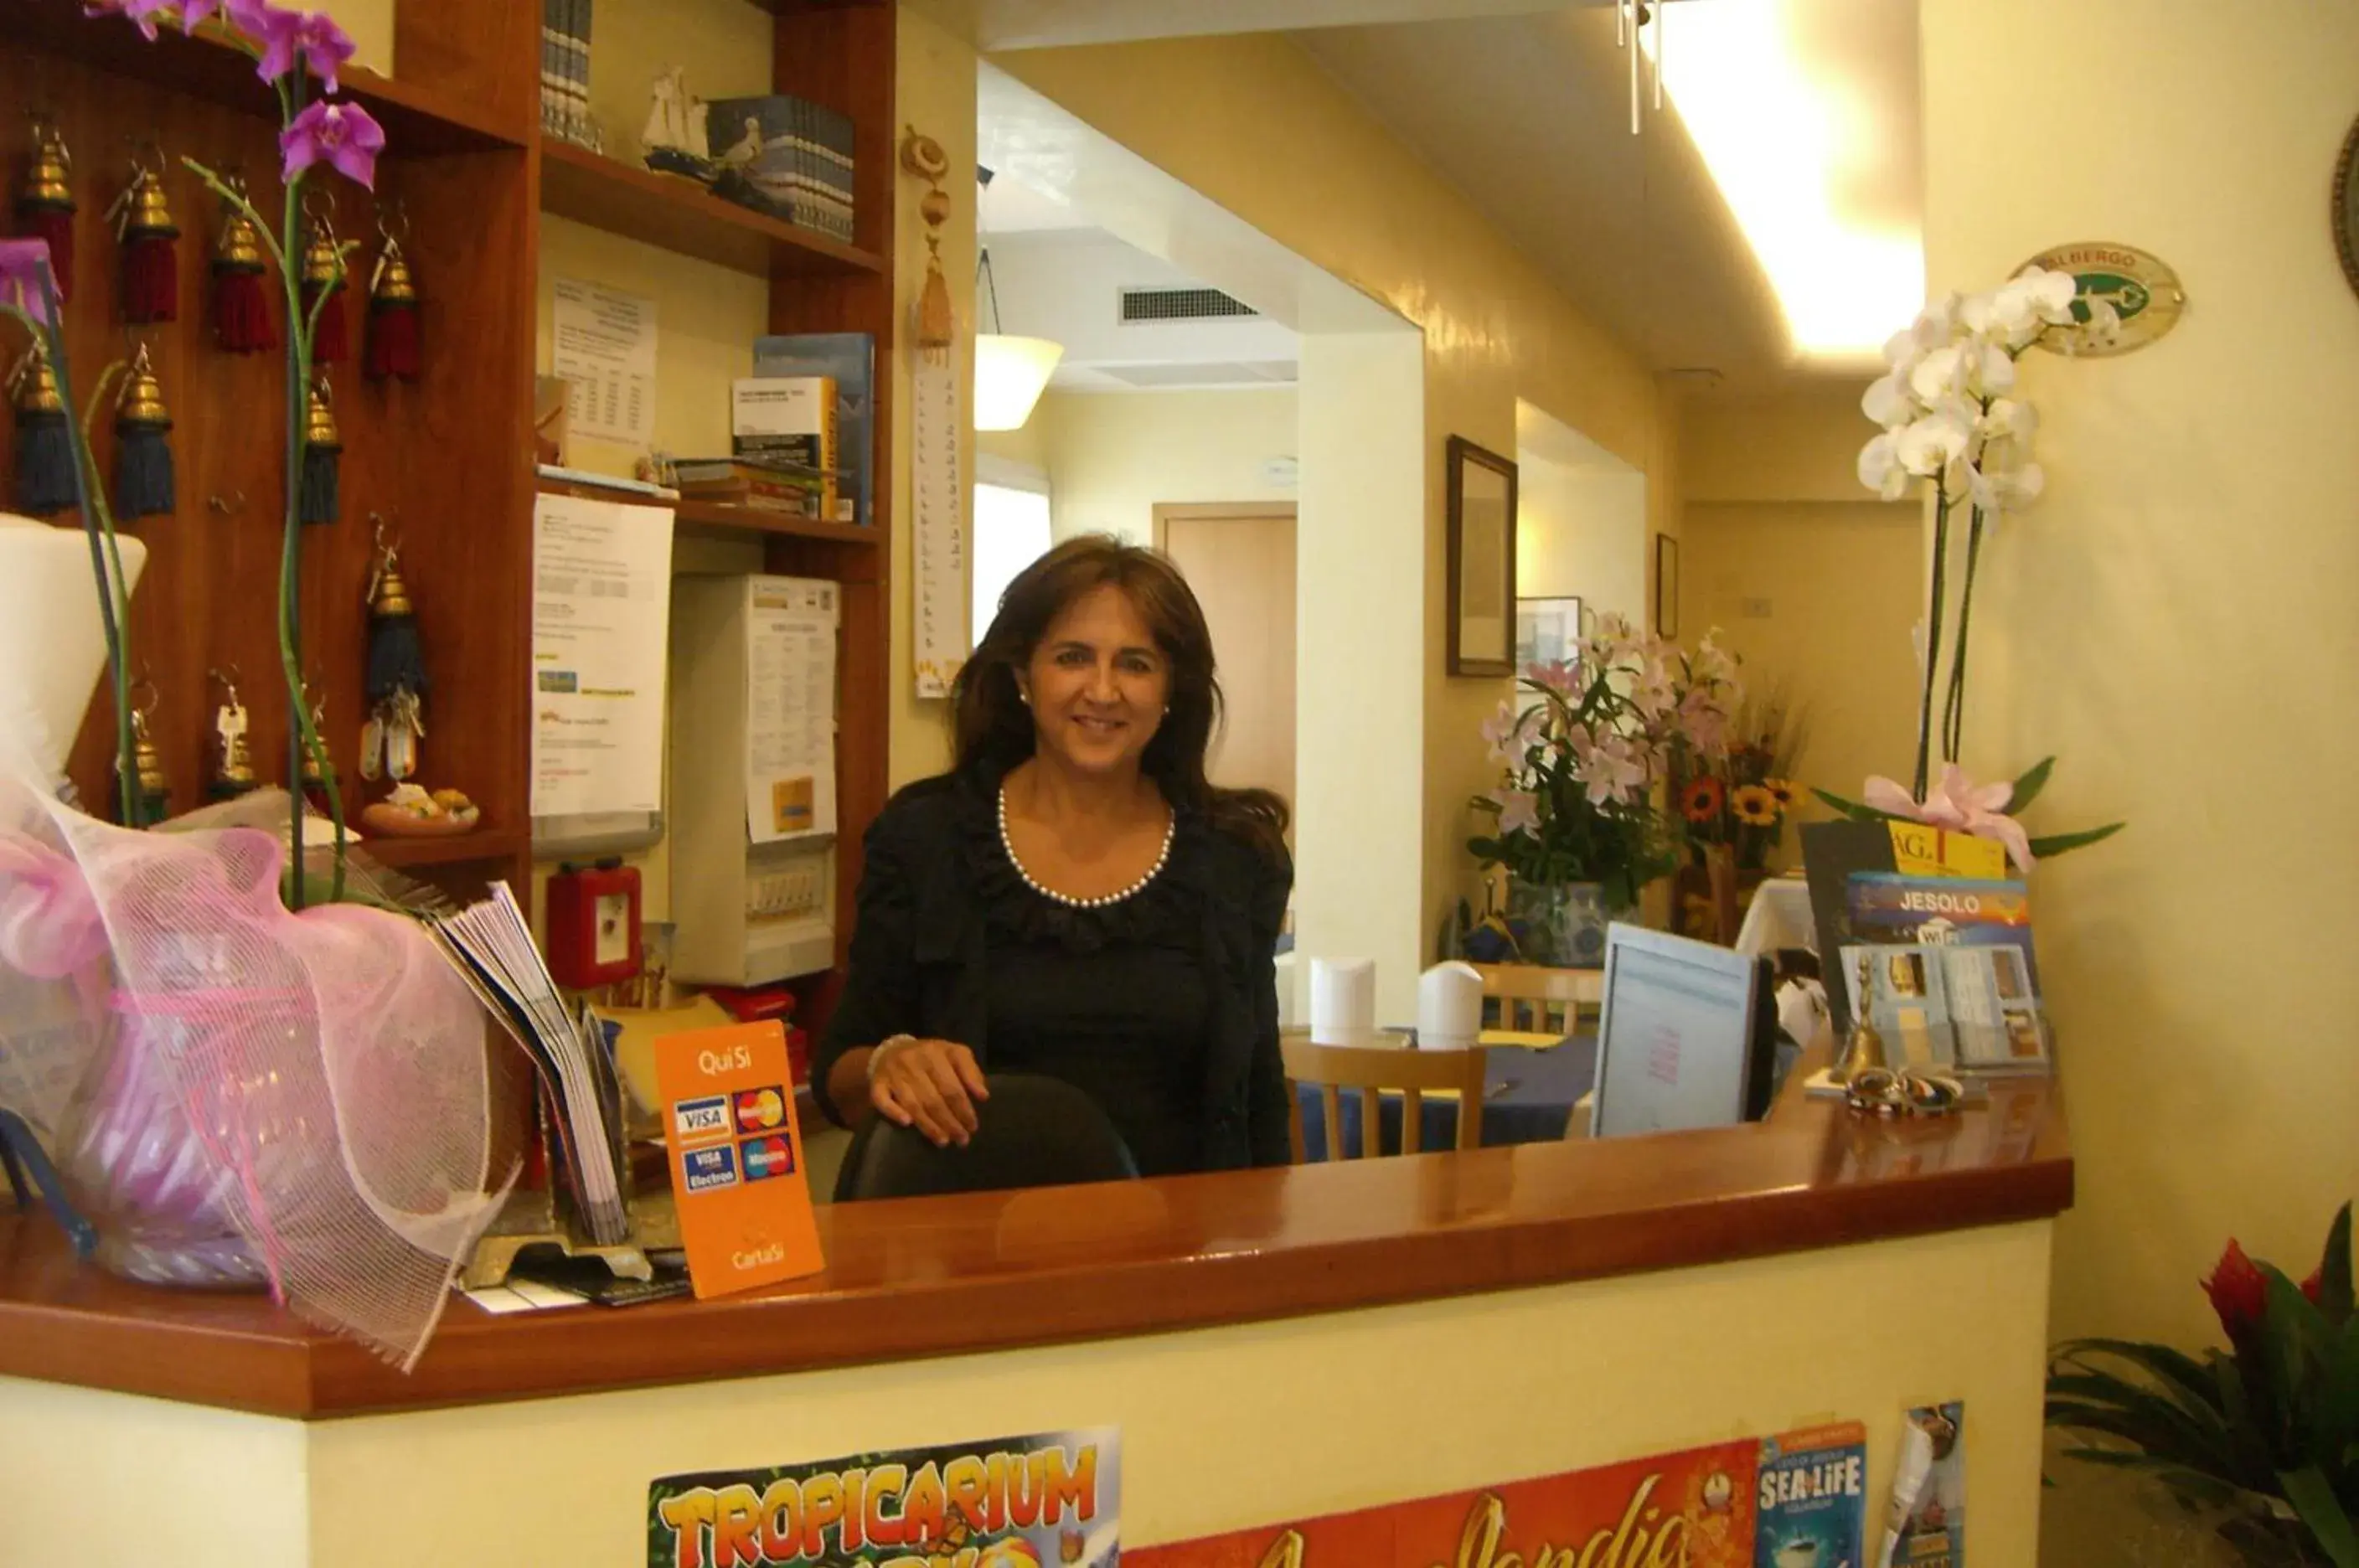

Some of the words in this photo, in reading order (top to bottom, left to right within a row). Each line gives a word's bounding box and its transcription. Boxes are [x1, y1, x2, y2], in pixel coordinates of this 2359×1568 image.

[1900, 891, 1980, 914] JESOLO
[685, 1110, 722, 1130] VISA
[695, 1150, 722, 1166] VISA
[1759, 1467, 1807, 1511] SEA
[658, 1443, 1098, 1568] TROPICARIUM
